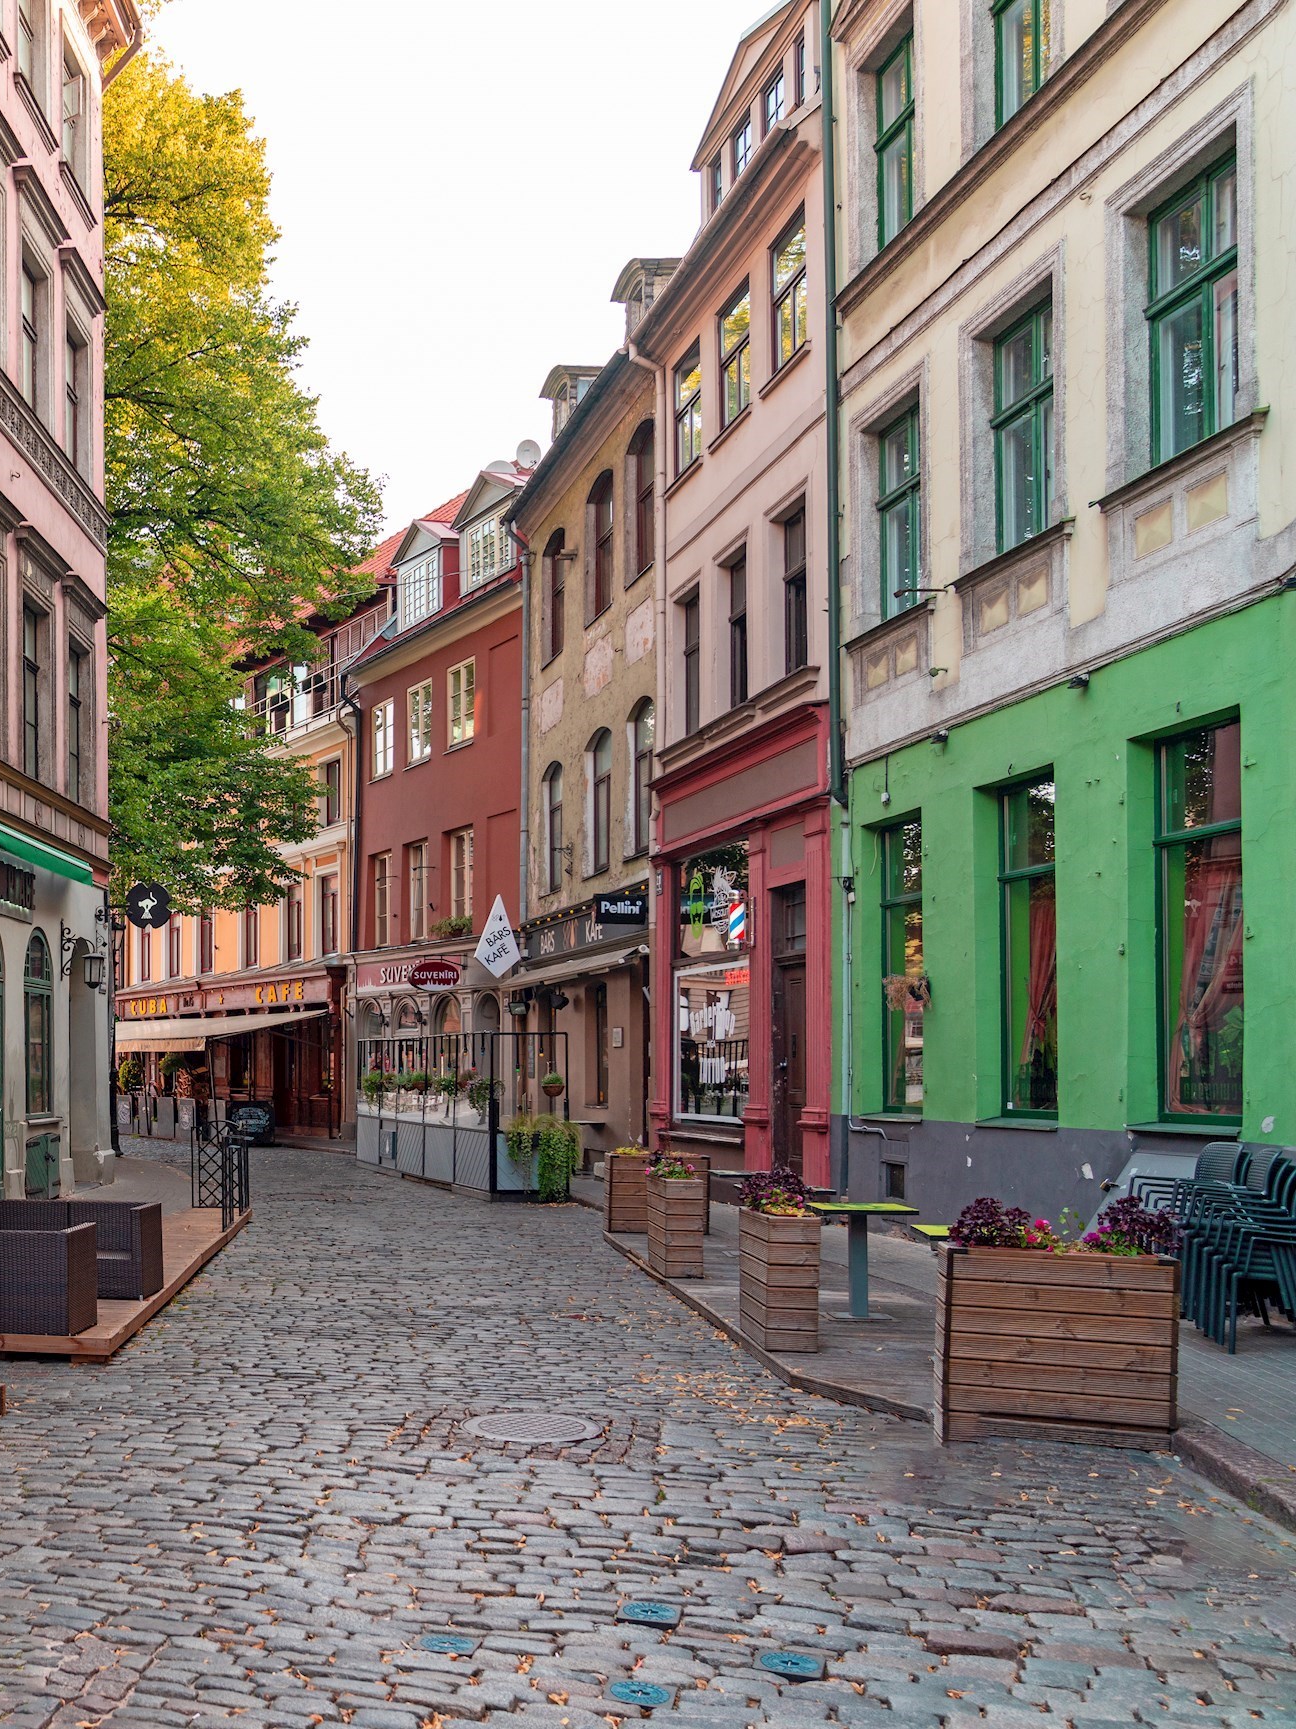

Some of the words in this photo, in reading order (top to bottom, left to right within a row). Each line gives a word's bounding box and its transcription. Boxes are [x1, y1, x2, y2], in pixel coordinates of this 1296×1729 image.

[600, 900, 642, 915] Pellini
[485, 926, 511, 947] BĀRS
[540, 929, 555, 955] BĀRS
[484, 943, 510, 966] KAFĒ
[414, 969, 457, 980] SUVENĪRI
[256, 981, 304, 1004] CAFE
[130, 998, 167, 1015] CUBA
